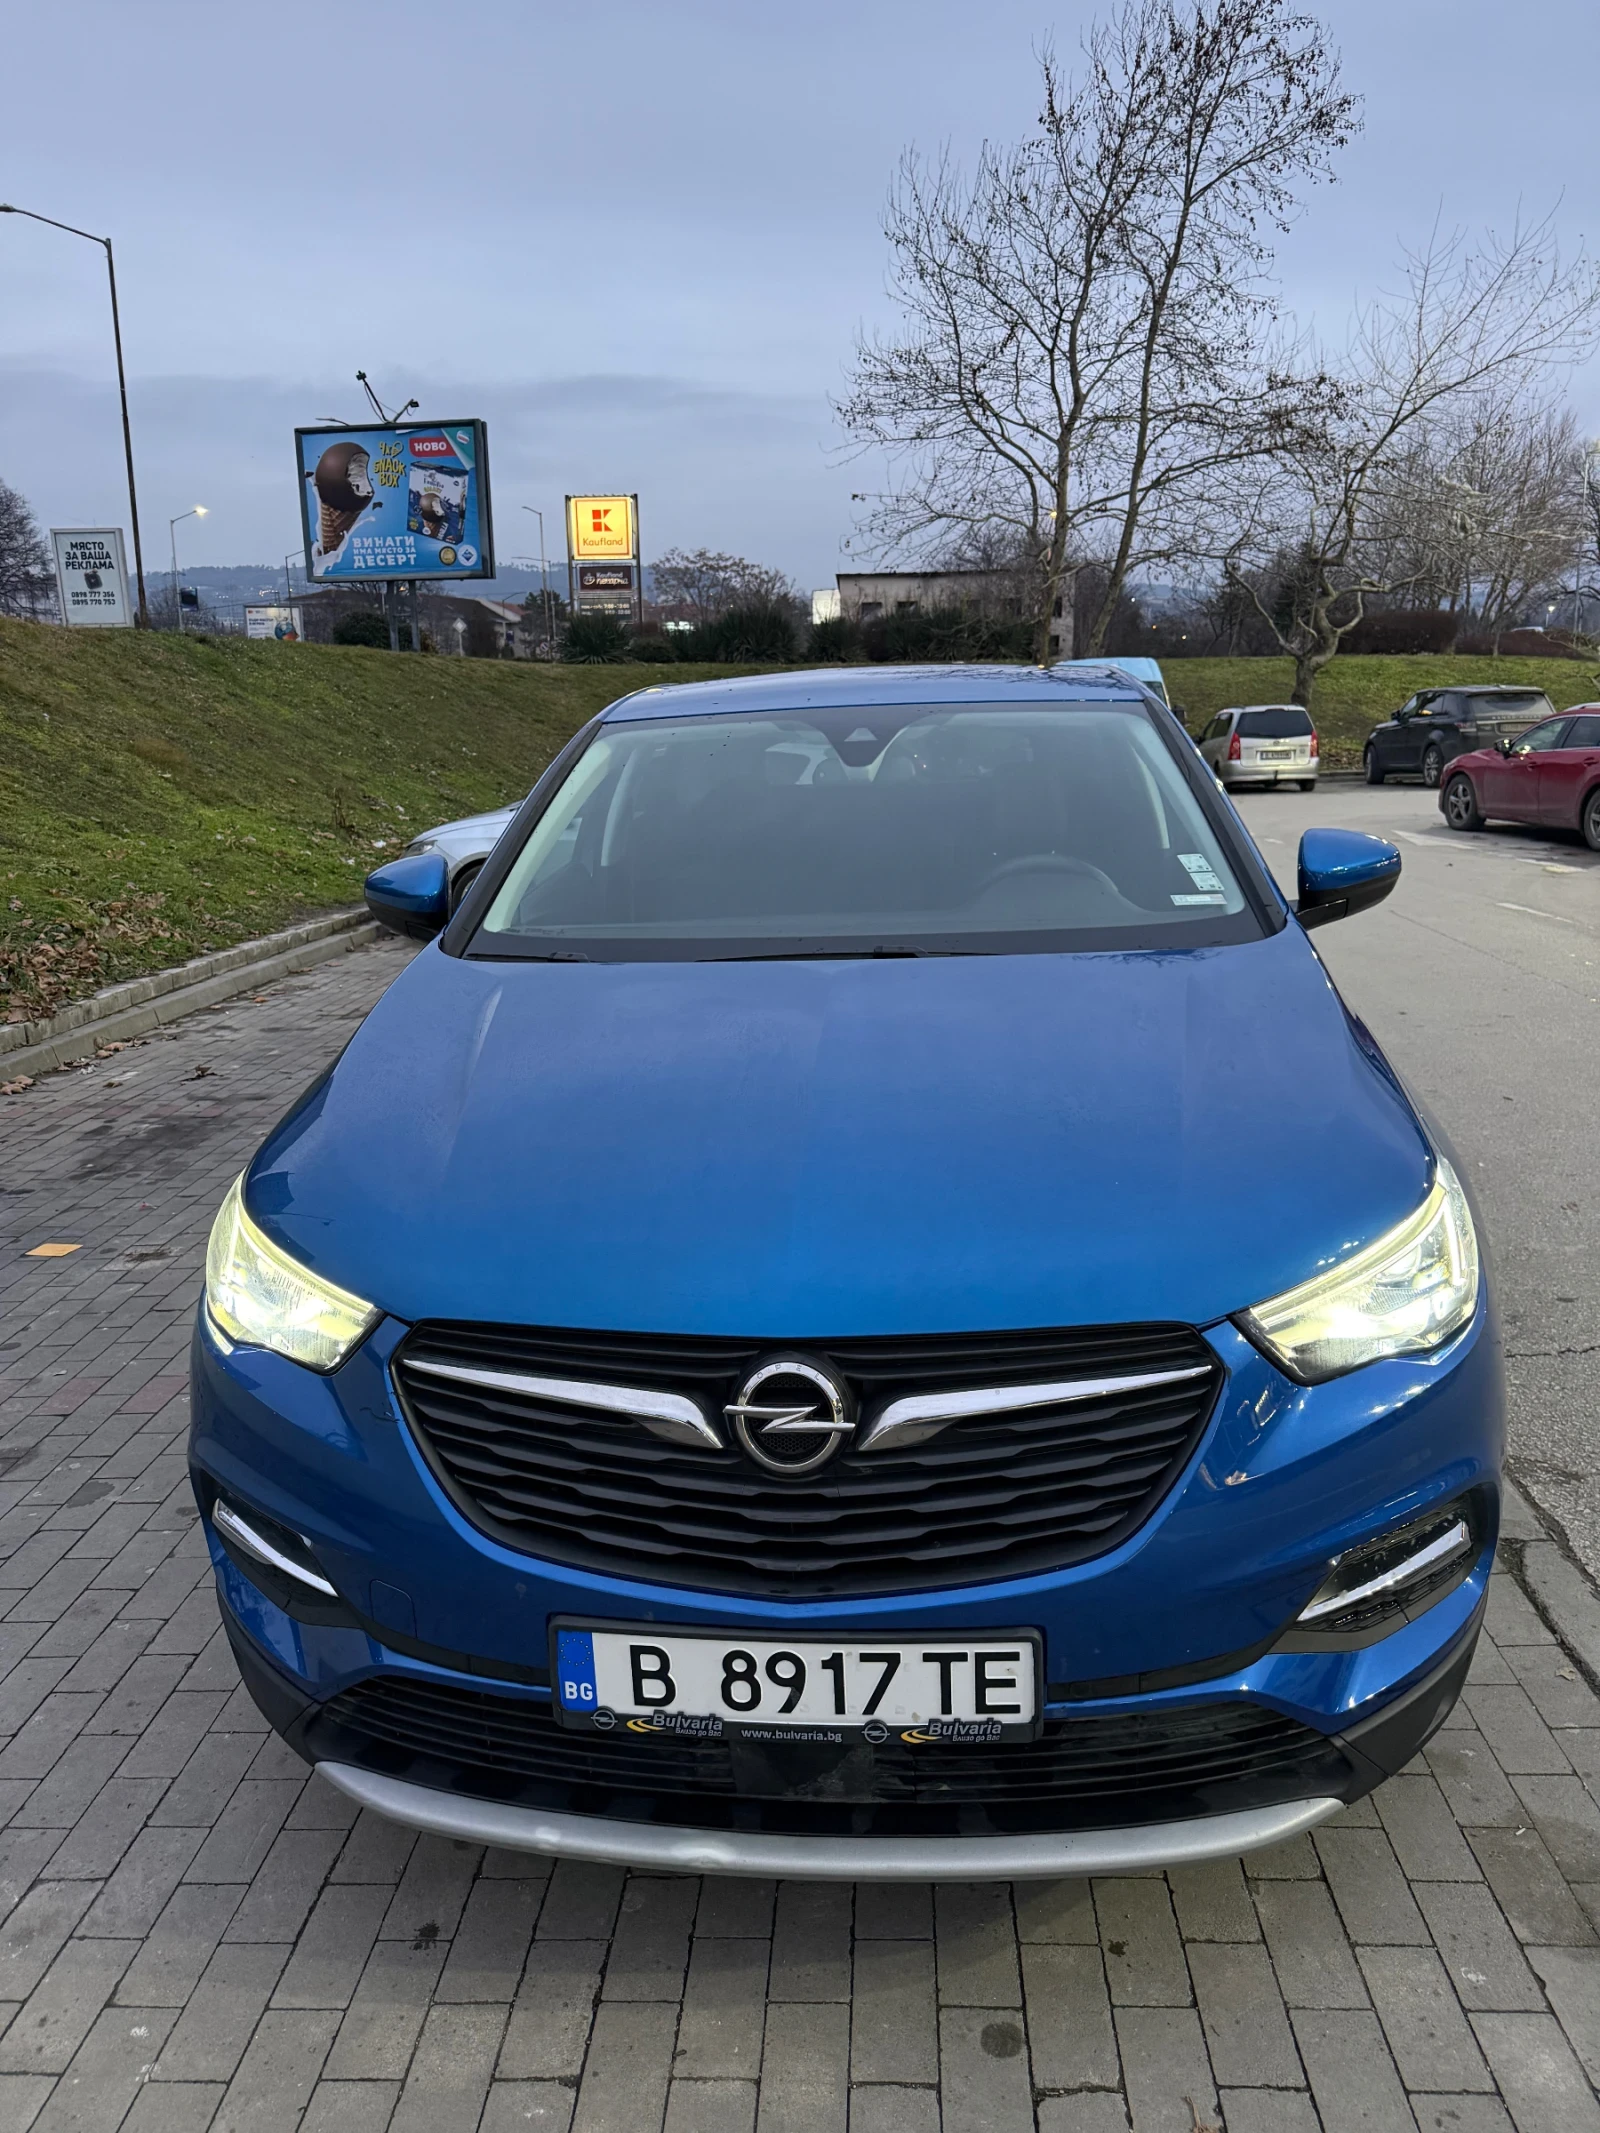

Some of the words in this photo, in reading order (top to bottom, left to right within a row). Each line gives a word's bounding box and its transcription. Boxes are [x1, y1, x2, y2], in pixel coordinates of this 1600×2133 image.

[414, 442, 447, 452] НОВО
[374, 458, 406, 476] SNACK
[380, 473, 399, 487] BOX
[70, 541, 105, 551] МЯСТО
[352, 536, 415, 548] ВИНАГИ
[583, 537, 623, 546] Kaufland
[65, 551, 79, 560] ЗА
[80, 551, 112, 560] ВАША
[353, 554, 417, 569] ДЕСЕРТ
[65, 561, 115, 570] РЕКЛАМА
[756, 1363, 821, 1381] OPEL
[629, 1645, 676, 1707] B
[721, 1649, 901, 1715] 8917
[922, 1652, 1021, 1715] TE
[564, 1681, 593, 1701] BG
[653, 1713, 723, 1731] Bulvaria
[928, 1721, 1002, 1736] Bulvaria
[741, 1728, 843, 1743] www.bulvaria.bg
